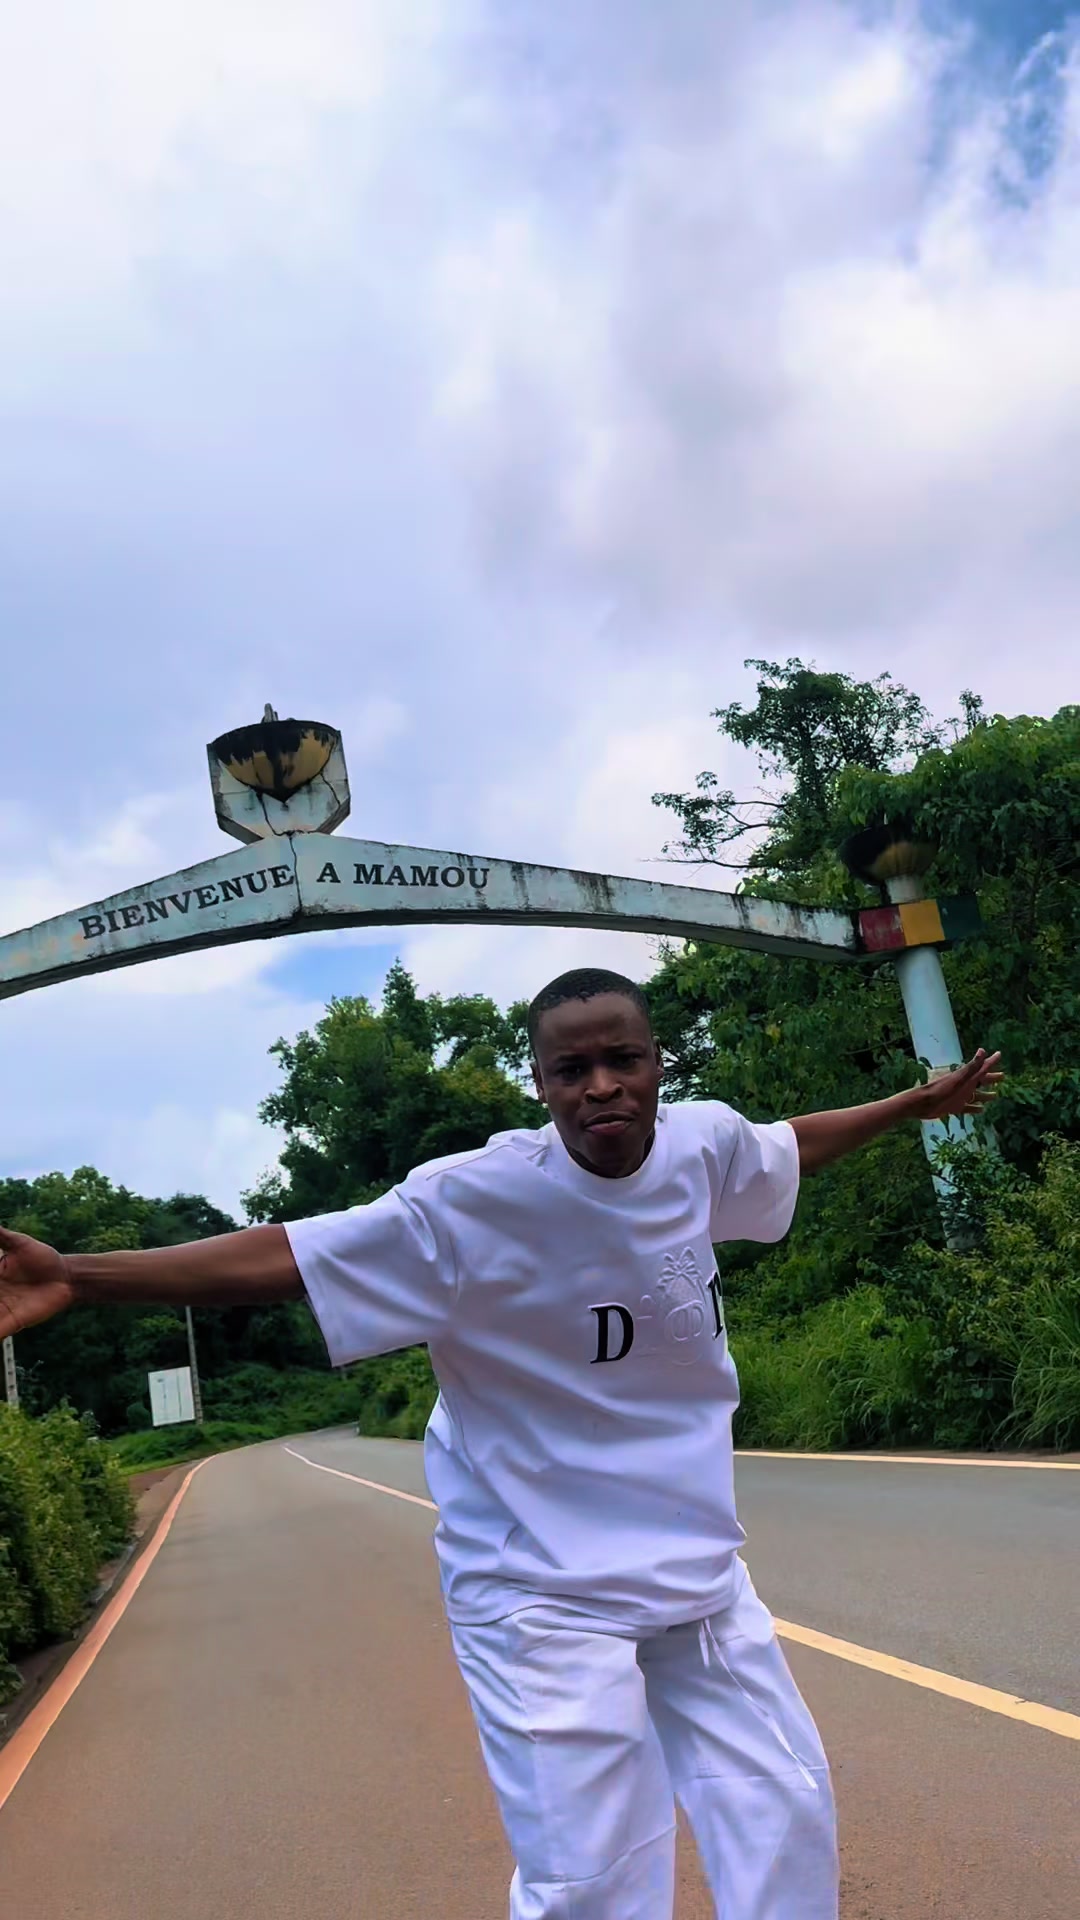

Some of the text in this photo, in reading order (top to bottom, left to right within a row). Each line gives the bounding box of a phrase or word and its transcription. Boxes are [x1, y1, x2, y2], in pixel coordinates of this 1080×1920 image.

[79, 862, 490, 939] BIENVENUE A MAMOU
